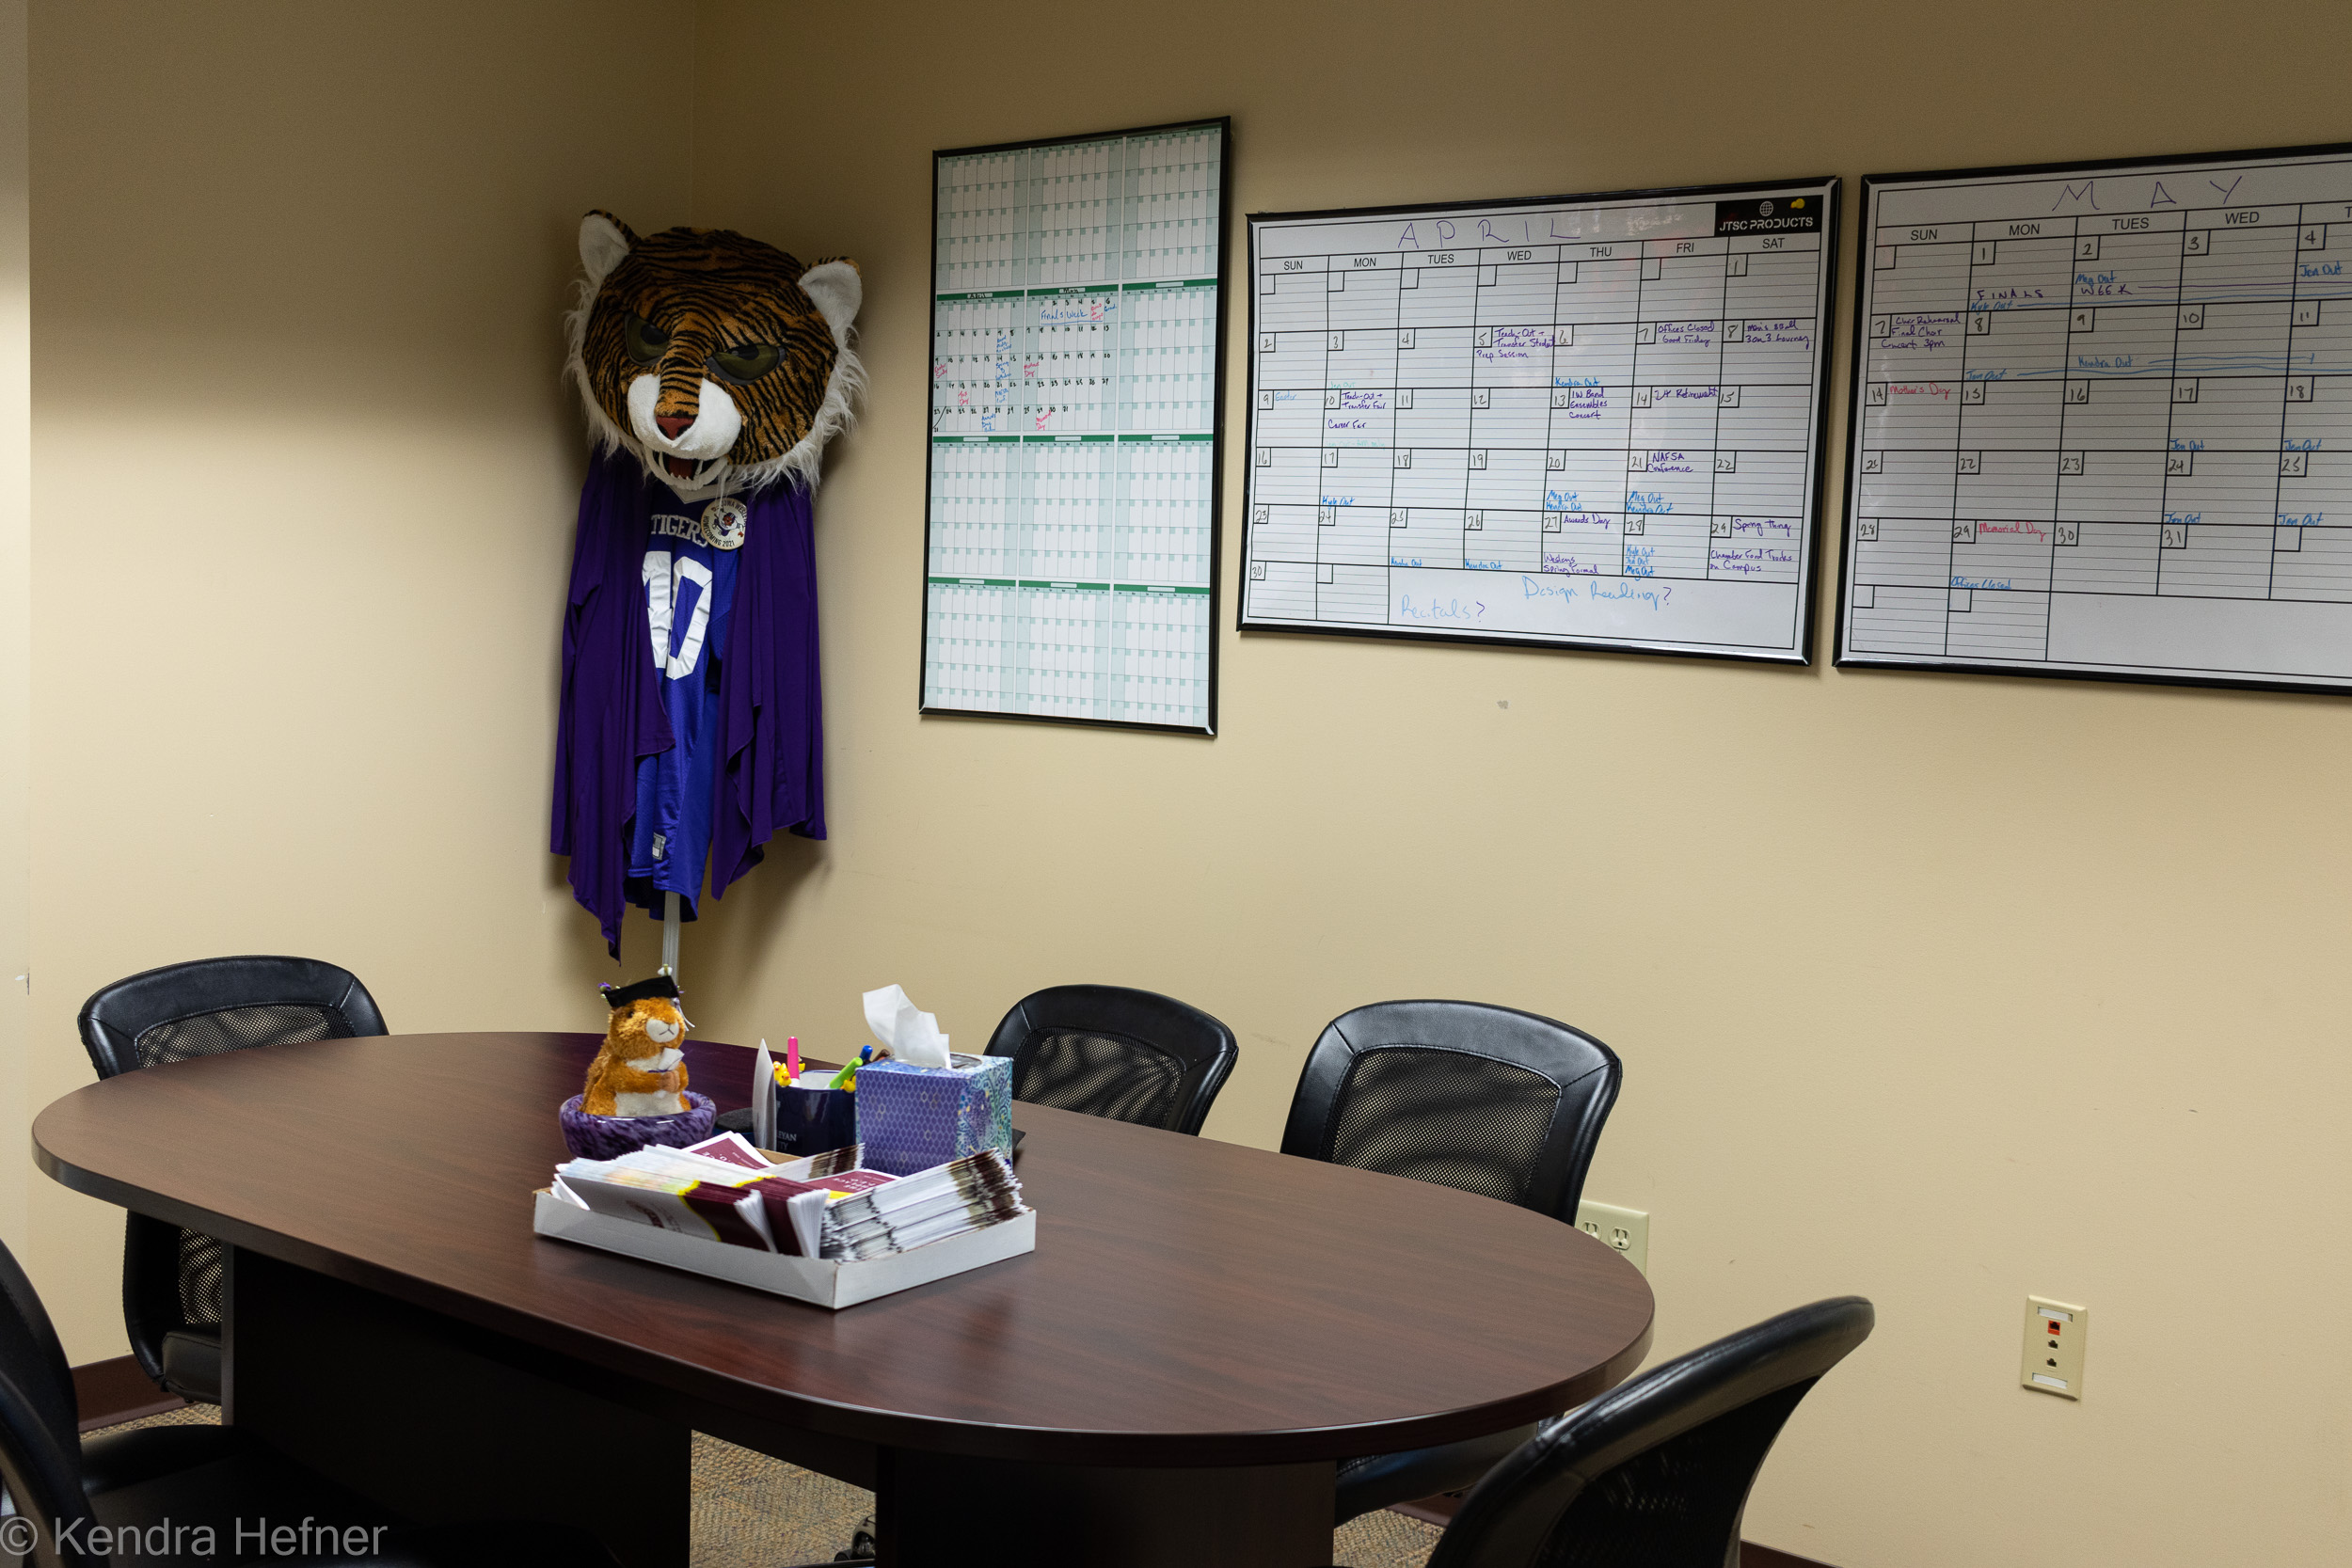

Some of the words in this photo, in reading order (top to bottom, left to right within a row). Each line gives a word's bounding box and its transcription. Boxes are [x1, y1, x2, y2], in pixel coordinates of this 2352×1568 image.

[2052, 176, 2243, 211] MAY
[1720, 220, 1747, 231] JTSC
[1750, 217, 1813, 230] PRODUCTS
[1911, 230, 1938, 240] SUN
[2009, 224, 2040, 235] MON
[2112, 217, 2149, 230] TUES
[2225, 212, 2259, 224] WED
[1398, 218, 1581, 249] APRIL
[2304, 230, 2316, 245] 4
[2188, 236, 2200, 249] 3
[1283, 261, 1303, 271] SUN
[1354, 257, 1376, 268] MON
[1428, 254, 1454, 264] TUES
[1507, 250, 1532, 261] WED
[1590, 246, 1612, 257] THU
[1677, 243, 1694, 253] FRI
[1762, 238, 1785, 248] SAT
[2082, 243, 2092, 256] 2
[2076, 314, 2085, 325] 9
[2183, 312, 2200, 324] 10
[2300, 311, 2310, 322] 11
[1975, 317, 1983, 332] 8
[1333, 337, 1339, 349] 3
[1402, 333, 1409, 344] 4
[1478, 332, 1487, 345] 5
[1720, 392, 1734, 404] 15
[1872, 388, 1883, 403] 14
[1929, 383, 1951, 400] Day
[1964, 388, 1980, 401] 15
[2070, 386, 2086, 402] 16
[2179, 388, 2194, 401] 17
[2290, 386, 2305, 399] 18
[1263, 394, 1269, 404] 9
[1326, 396, 1335, 405] 10
[1401, 395, 1409, 405] 11
[1473, 394, 1486, 404] 12
[1555, 395, 1565, 406] 13
[1636, 393, 1647, 406] 14
[1258, 451, 1266, 465] 16
[1324, 452, 1335, 465] 17
[1397, 454, 1408, 467] 18
[1472, 454, 1483, 467] 19
[1549, 457, 1561, 468] 20
[1631, 456, 1643, 468] 21
[1652, 451, 1685, 463] NAFSA
[1717, 459, 1734, 470] 22
[1961, 458, 1976, 470] 22
[2062, 458, 2080, 471] 23
[2169, 459, 2184, 472] 24
[2281, 456, 2300, 472] 25
[1255, 510, 1267, 523] 23
[1468, 515, 1480, 529] 26
[1545, 516, 1558, 529] 27
[703, 515, 722, 546] HOMECOMING
[1860, 524, 1875, 537] 28
[1954, 526, 1970, 539] 29
[2026, 522, 2047, 543] Day
[2058, 527, 2074, 544] 30
[2164, 530, 2182, 546] 31
[1252, 565, 1262, 577] 30
